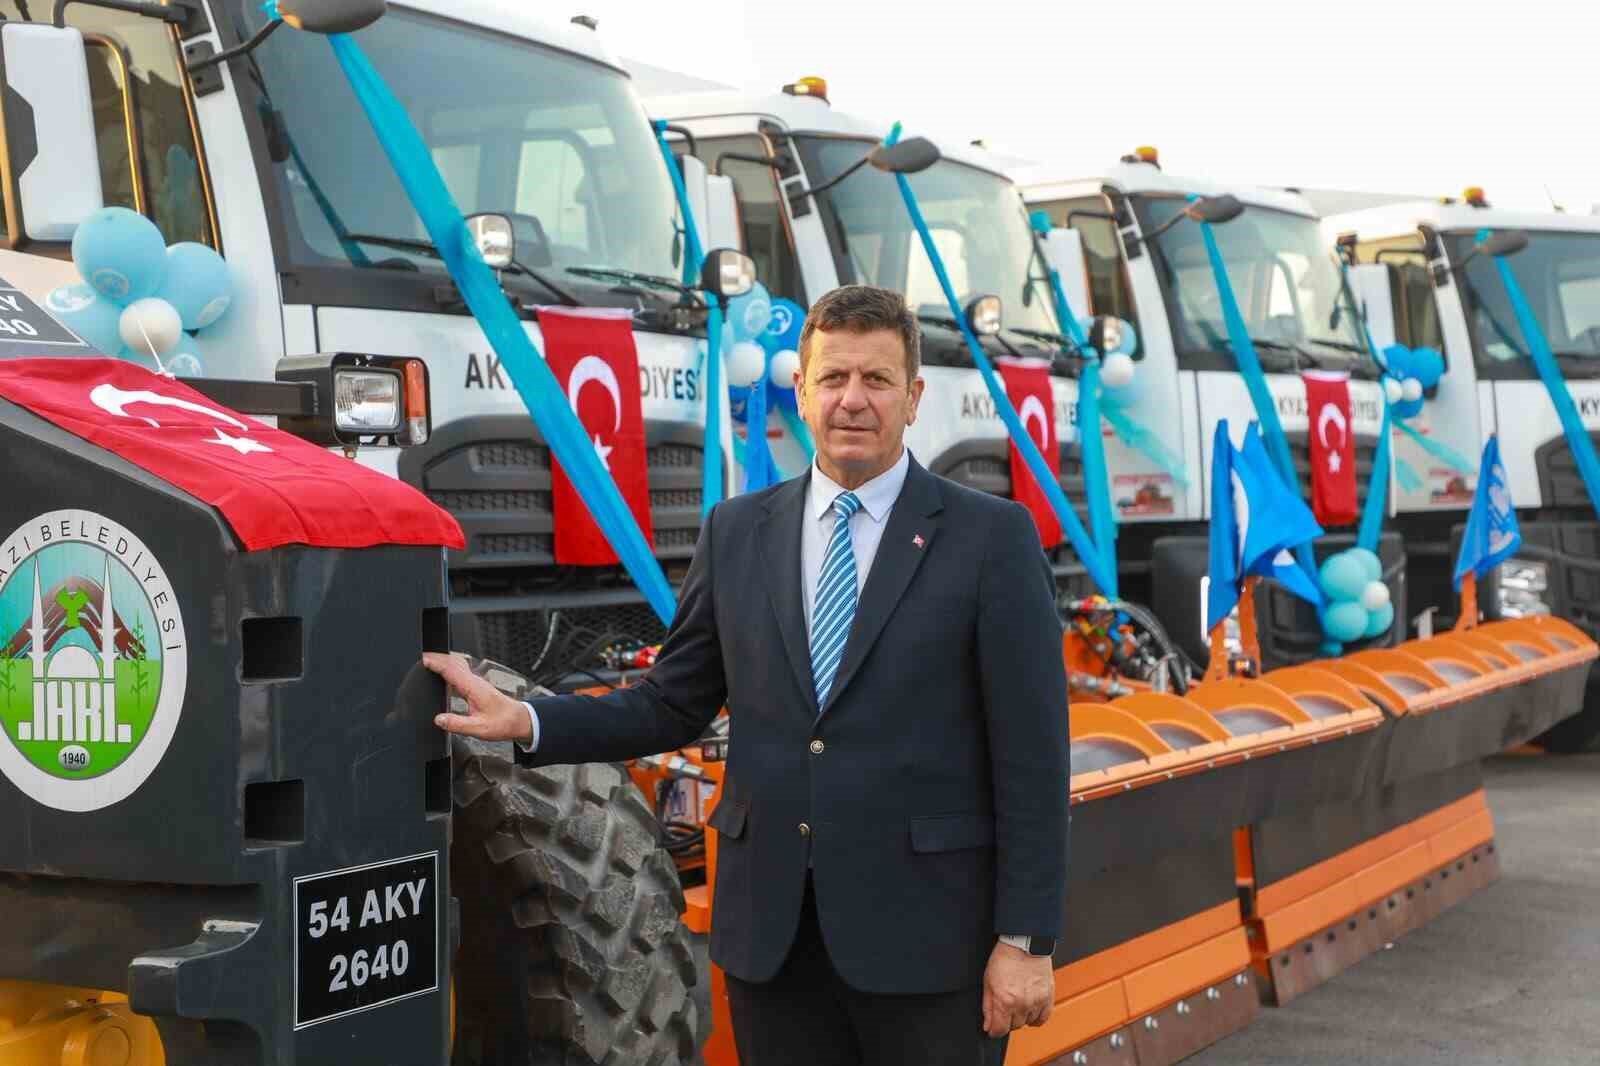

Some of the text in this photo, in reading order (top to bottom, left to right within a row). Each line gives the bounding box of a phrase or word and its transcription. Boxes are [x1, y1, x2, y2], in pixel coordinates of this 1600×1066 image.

[0, 295, 23, 311] Y
[0, 318, 38, 335] 40
[464, 353, 505, 390] AK
[1580, 397, 1600, 417] KY
[62, 752, 86, 765] 1940
[308, 878, 427, 938] 54 AKY
[328, 939, 409, 993] 2640
